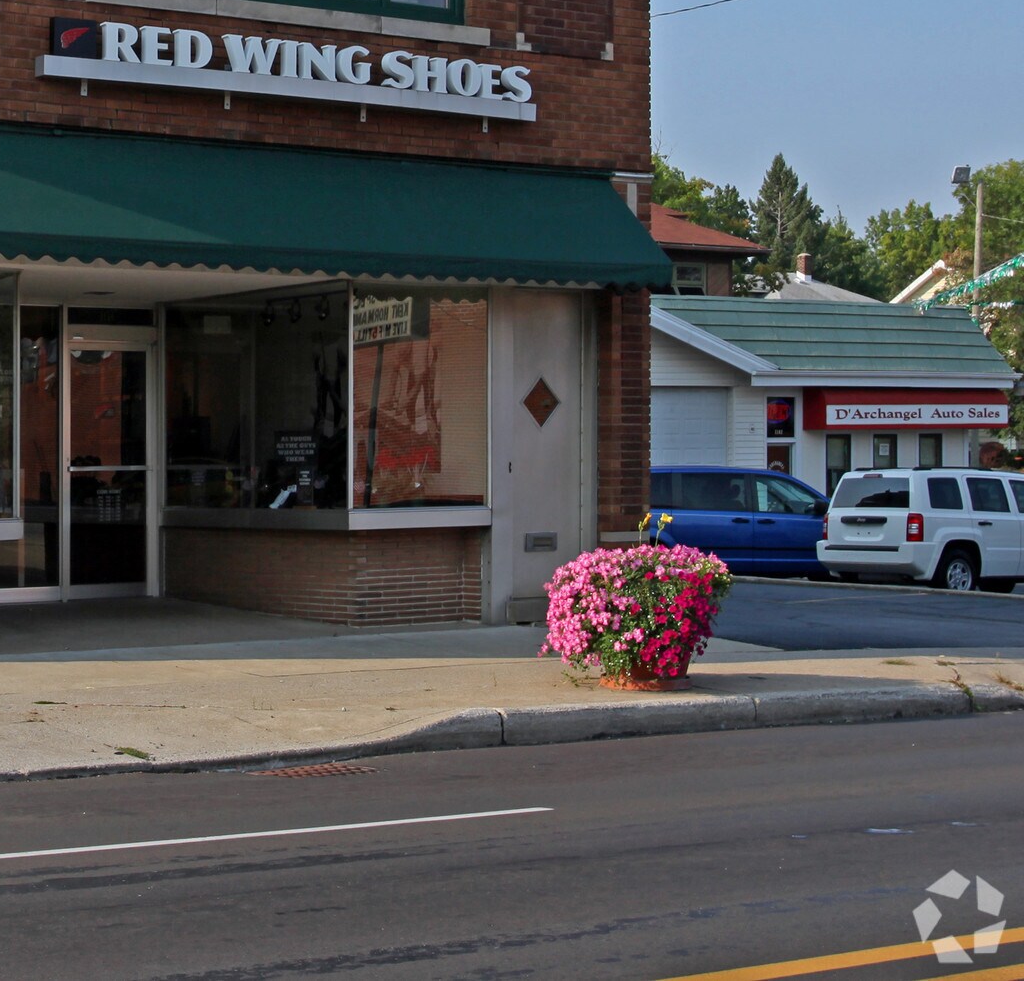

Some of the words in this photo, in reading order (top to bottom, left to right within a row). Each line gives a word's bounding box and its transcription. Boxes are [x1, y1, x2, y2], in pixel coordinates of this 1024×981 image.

[99, 21, 213, 70] RED
[221, 33, 372, 85] WING
[381, 50, 532, 103] SHOES
[835, 408, 922, 421] D'Archangel
[930, 408, 964, 419] Auto
[968, 407, 1000, 419] Sales
